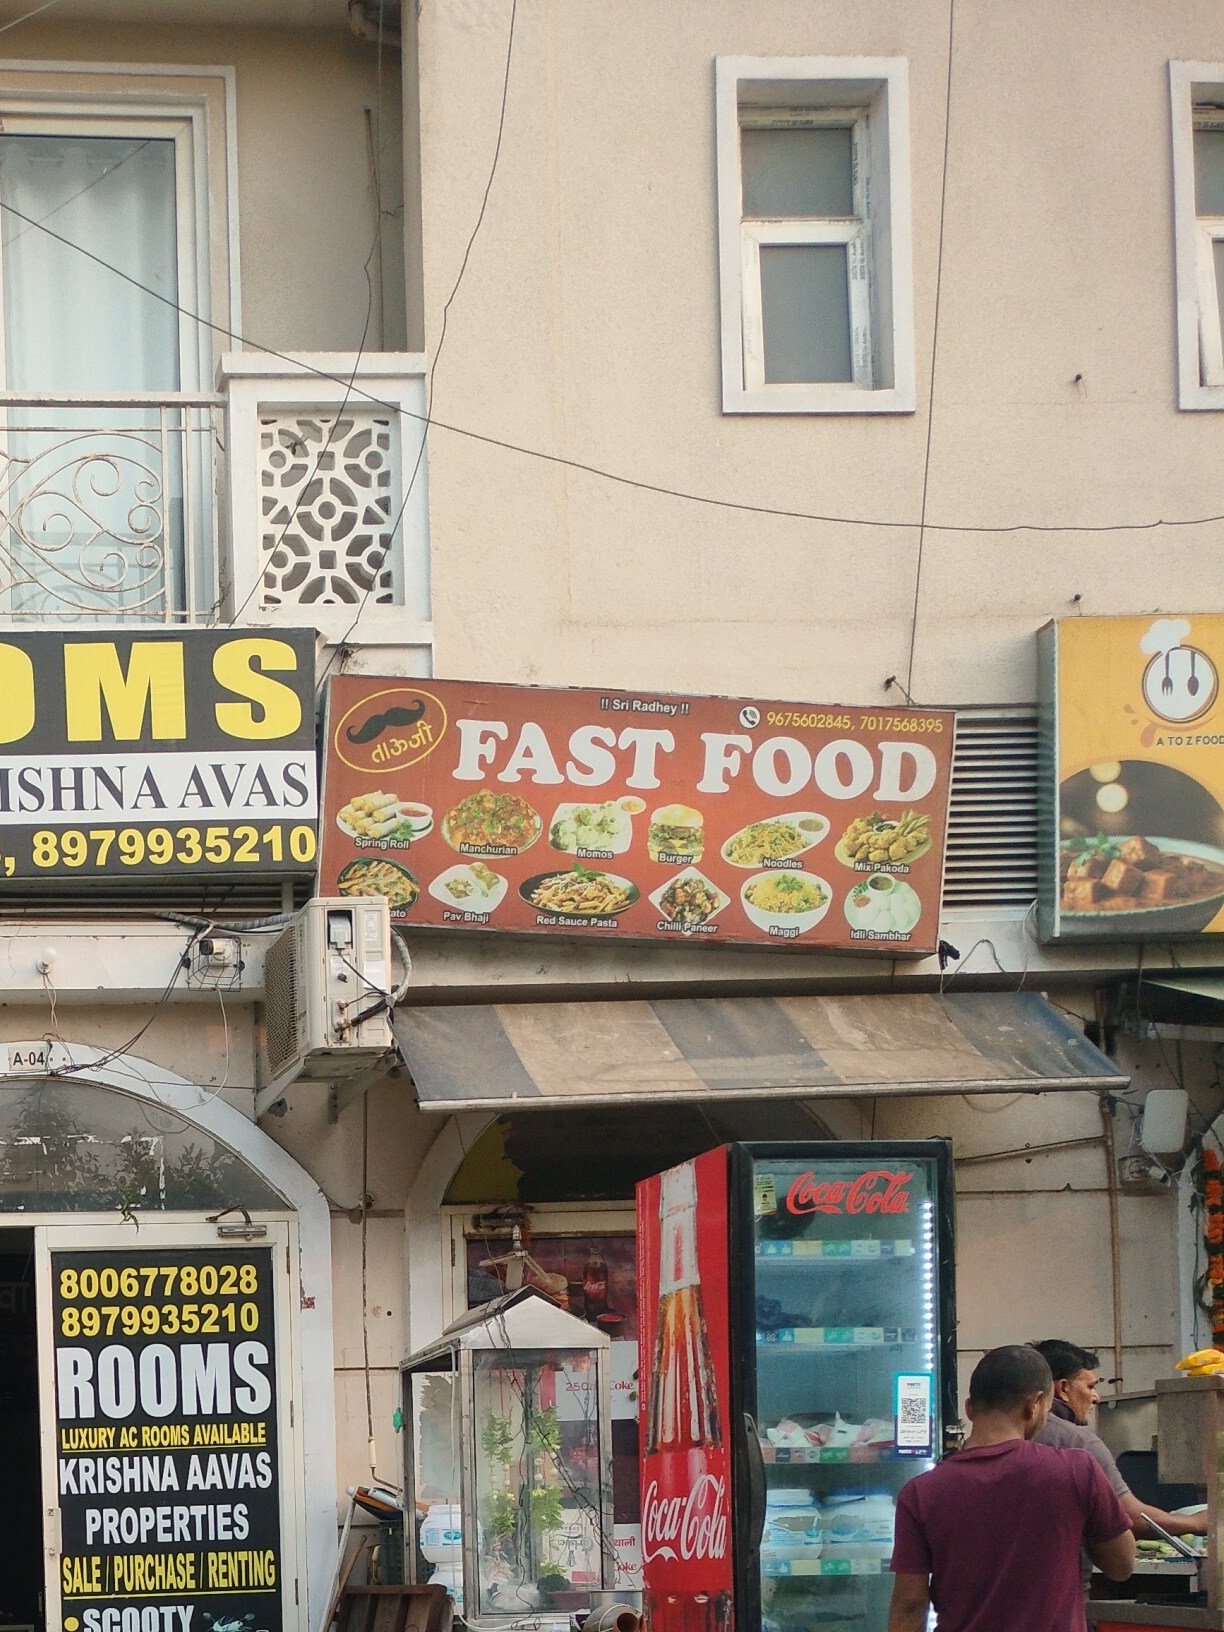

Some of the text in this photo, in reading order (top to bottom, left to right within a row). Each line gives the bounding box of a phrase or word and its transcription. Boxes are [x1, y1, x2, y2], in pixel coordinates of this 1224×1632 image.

[612, 699, 630, 711] Sri
[632, 701, 677, 715] Radhey
[766, 712, 943, 733] 9675602845, 7017568395
[1156, 736, 1164, 746] A
[1168, 735, 1184, 746] TO
[1186, 735, 1193, 745] Z
[452, 719, 936, 801] FAST FOOD
[178, 762, 310, 808] AVAS
[32, 825, 316, 868] 8979935210
[355, 837, 409, 850] Spring Roll
[460, 843, 518, 855] Manchurian
[577, 848, 613, 859] Momos
[659, 853, 692, 865] Burger
[763, 858, 803, 869] Noodles
[874, 863, 910, 874] Pakoda
[443, 911, 489, 924] Pav Bhaji
[536, 915, 617, 928] Red Sauce Pasta
[656, 921, 718, 934] Chilli Paneer
[769, 926, 800, 938] Maggi
[850, 930, 911, 941] Idli Sambhar
[13, 1052, 45, 1066] A-04
[786, 1170, 914, 1215] Coca-Cola
[59, 1264, 258, 1299] 8006778028
[61, 1302, 259, 1337] 8979935210
[56, 1340, 271, 1420] ROOMS
[61, 1422, 267, 1450] LUXURY AC ROOMS AVAILABLE
[59, 1452, 273, 1495] KRISHNA AAVAS
[85, 1503, 250, 1546] PROPERTIES
[642, 1474, 727, 1561] Coca-Cola
[62, 1556, 102, 1594] SALE
[114, 1552, 196, 1592] PURCHASE
[207, 1550, 276, 1588] RENTING
